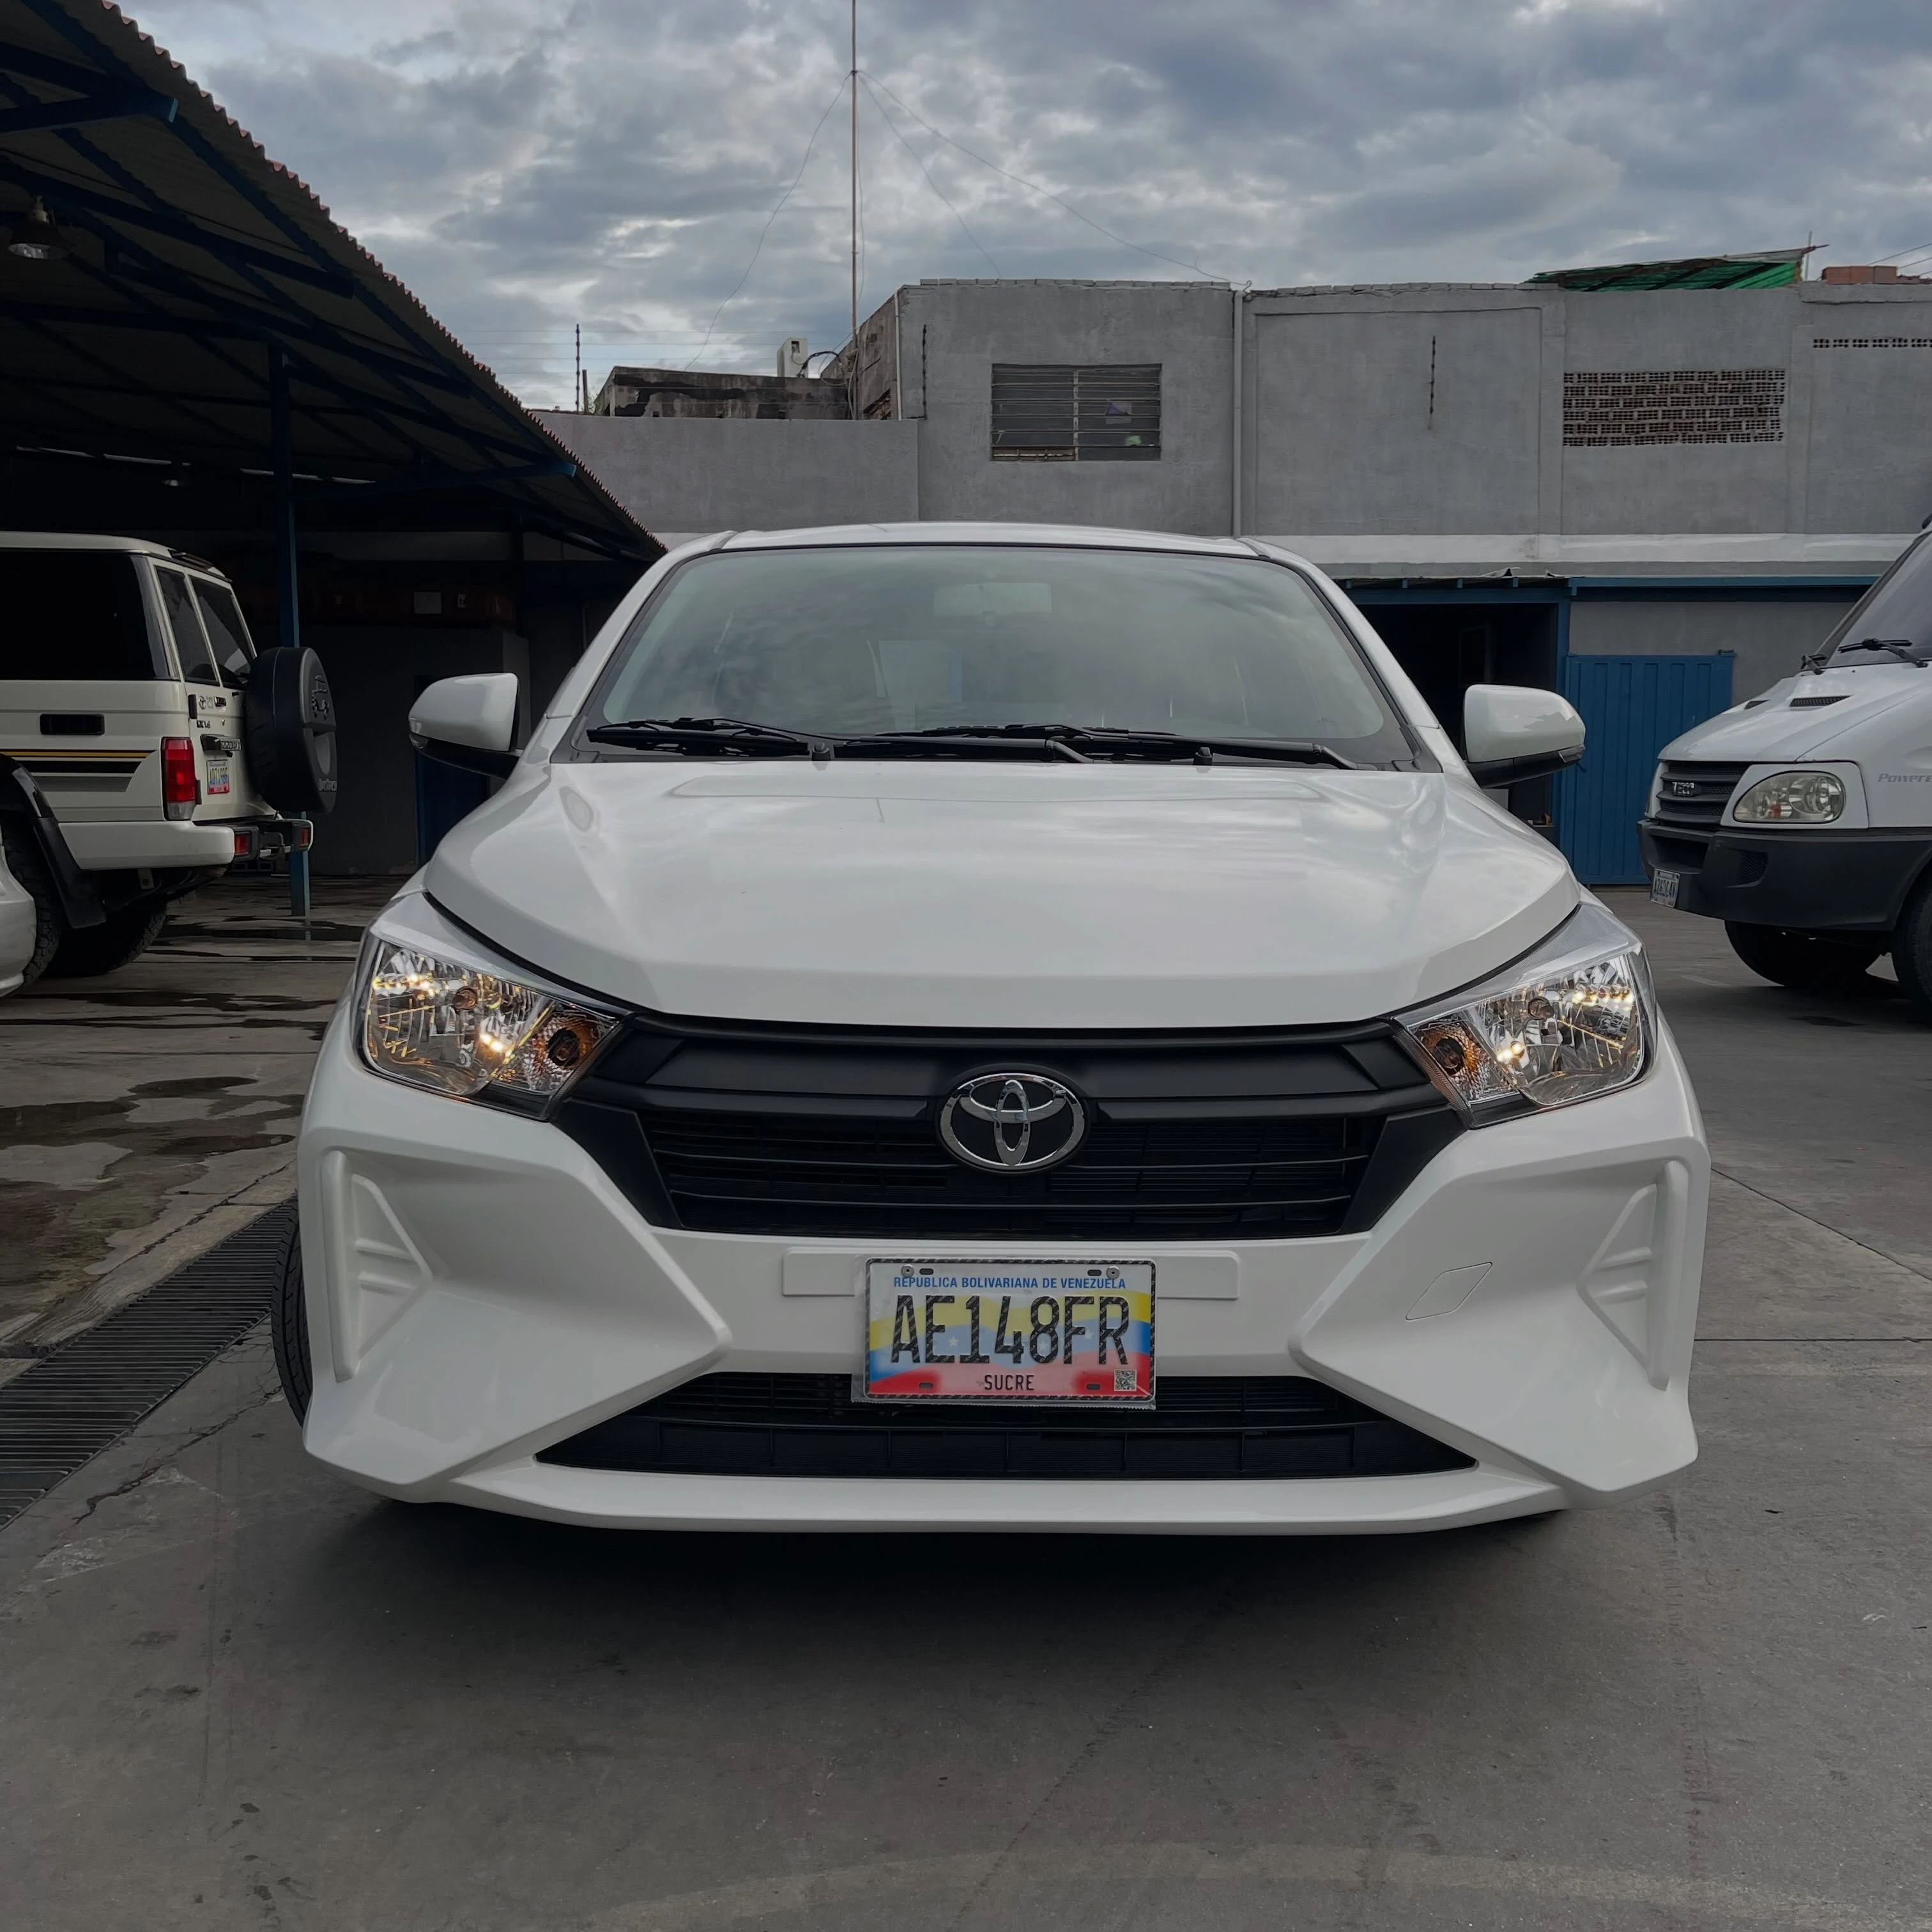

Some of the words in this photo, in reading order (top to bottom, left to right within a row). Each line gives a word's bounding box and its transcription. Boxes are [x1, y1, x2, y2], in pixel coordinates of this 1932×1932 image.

[894, 1277, 957, 1288] REPUBLICA
[962, 1277, 1038, 1289] BOLIVARIANA
[1042, 1277, 1057, 1289] DE
[1061, 1277, 1126, 1289] VENEZUELA
[891, 1294, 1130, 1365] AE148FR
[984, 1374, 1035, 1391] SUCRE
